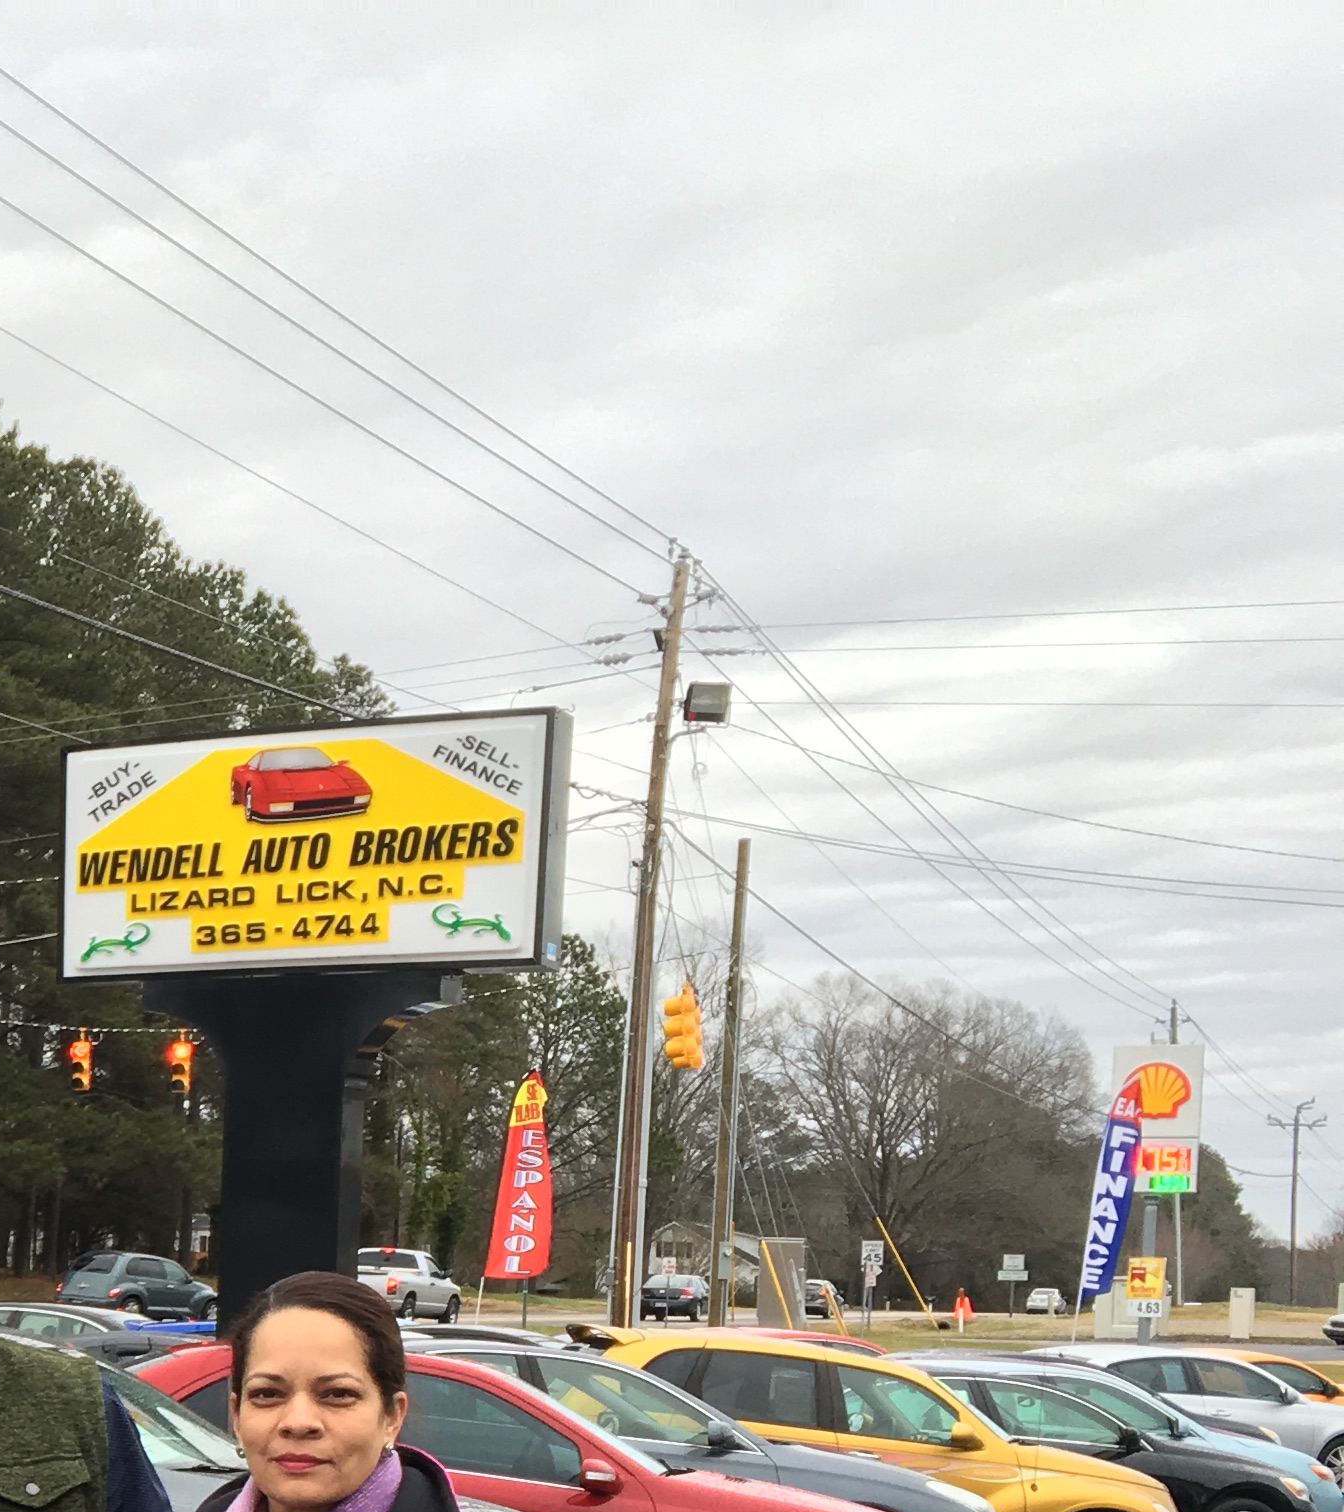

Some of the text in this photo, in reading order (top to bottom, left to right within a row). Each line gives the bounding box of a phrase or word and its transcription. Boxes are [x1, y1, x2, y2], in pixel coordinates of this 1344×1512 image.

[433, 744, 523, 796] FINANCE
[87, 770, 157, 823] TRADE
[79, 817, 519, 887] WENDELL AUTO BROKERS
[131, 874, 453, 913] LIZARD LICK, N.C.
[196, 912, 380, 946] 365-4744
[504, 1129, 544, 1274] ESPAÑOL
[1083, 1125, 1139, 1290] FINANCE
[863, 1253, 882, 1263] 45
[1137, 1302, 1160, 1314] 4.63
